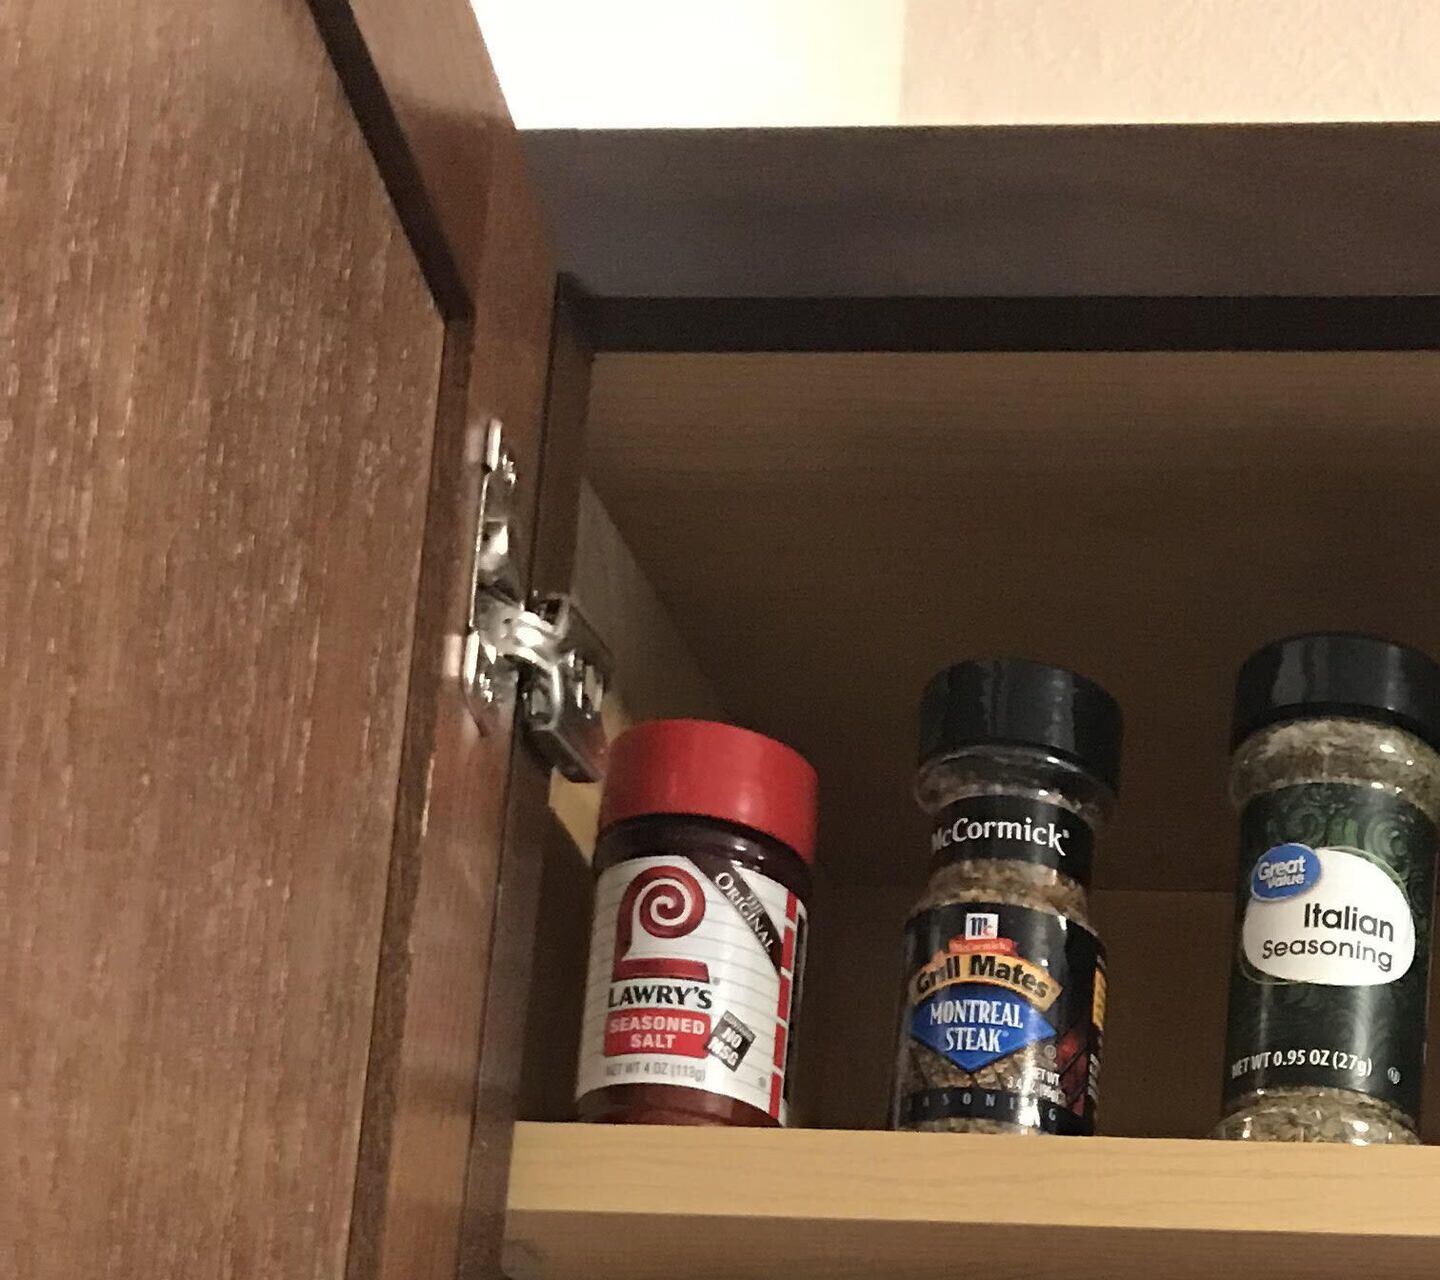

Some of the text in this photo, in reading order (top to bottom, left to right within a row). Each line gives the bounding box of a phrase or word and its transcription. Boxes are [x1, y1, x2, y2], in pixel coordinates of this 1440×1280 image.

[931, 817, 1067, 857] McCormick
[1258, 856, 1306, 880] Great
[716, 872, 772, 953] ORIGINAL
[1304, 902, 1395, 942] Italian
[1262, 939, 1393, 972] Seasoning
[917, 954, 1050, 999] Grill Mates
[608, 985, 712, 1010] LAWRY'S
[609, 1016, 705, 1035] SEASONED
[930, 999, 1023, 1029] MONTREAL
[631, 1034, 676, 1049] SALT
[707, 1036, 739, 1066] MSG
[722, 1027, 743, 1048] NO
[944, 1027, 1001, 1053] STEAK
[625, 1061, 641, 1075] WT
[643, 1062, 650, 1073] 4
[1231, 1049, 1373, 1079] NET WT 0.95 OZ (27g)
